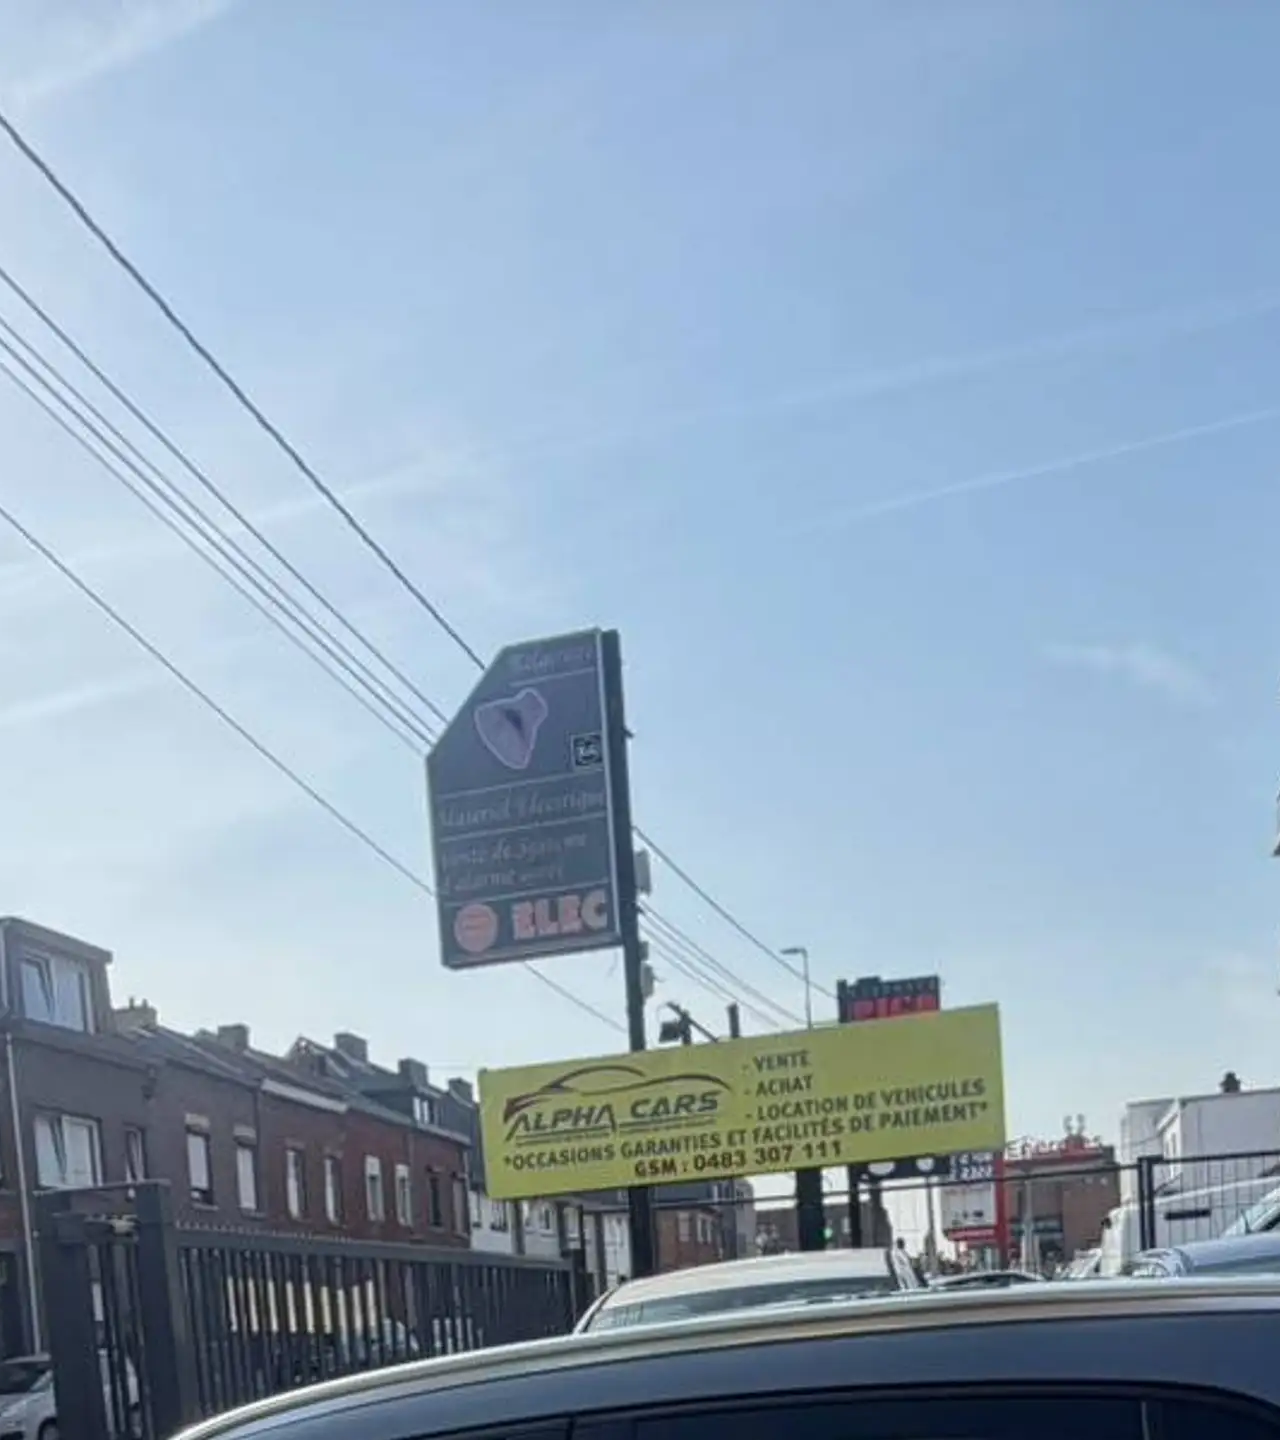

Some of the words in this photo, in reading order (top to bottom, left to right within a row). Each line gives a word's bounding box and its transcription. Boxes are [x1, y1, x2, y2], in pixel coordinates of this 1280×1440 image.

[511, 889, 608, 941] ELEC
[753, 1050, 810, 1072] VENTE
[755, 1075, 813, 1096] ACHAT
[757, 1096, 848, 1121] LOCATION
[853, 1092, 876, 1112] DE
[879, 1077, 986, 1106] VEHICULES
[504, 1104, 617, 1142] ALPHA
[629, 1090, 723, 1119] CARS
[620, 1133, 721, 1159] GARANTIES
[726, 1129, 746, 1147] ET
[752, 1116, 845, 1143] FACILITÉS
[850, 1114, 876, 1133] DE
[634, 1158, 677, 1177] GSM
[693, 1151, 746, 1172] 0483
[754, 1143, 793, 1165] 307
[802, 1140, 842, 1159] 111
